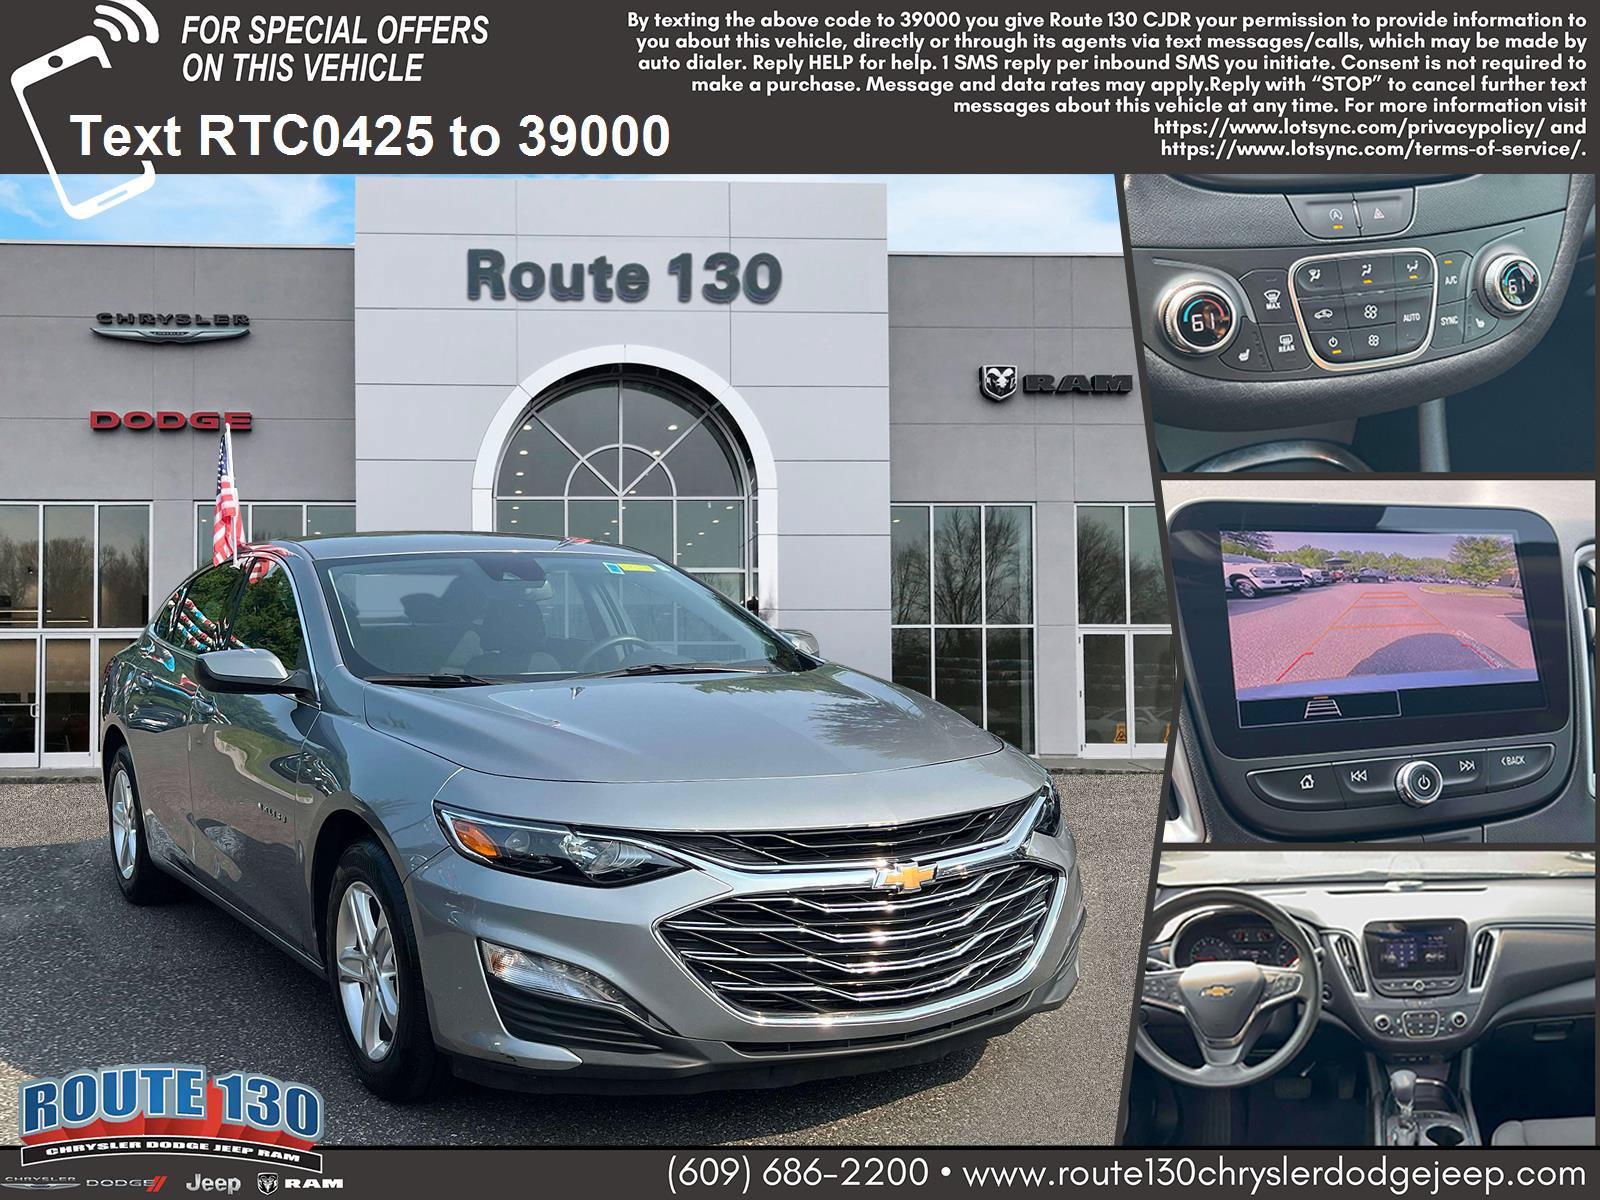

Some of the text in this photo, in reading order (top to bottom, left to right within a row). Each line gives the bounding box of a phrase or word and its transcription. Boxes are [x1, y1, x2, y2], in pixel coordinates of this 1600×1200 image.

[466, 248, 783, 305] Route 130
[1266, 302, 1281, 310] MAX
[96, 312, 250, 326] CHRYSLER
[1192, 312, 1215, 332] 61
[1403, 312, 1421, 322] AUTO
[1440, 316, 1459, 326] SYNC
[1278, 344, 1296, 353] REAR
[1023, 374, 1133, 394] RAM
[89, 410, 253, 431] DODGE
